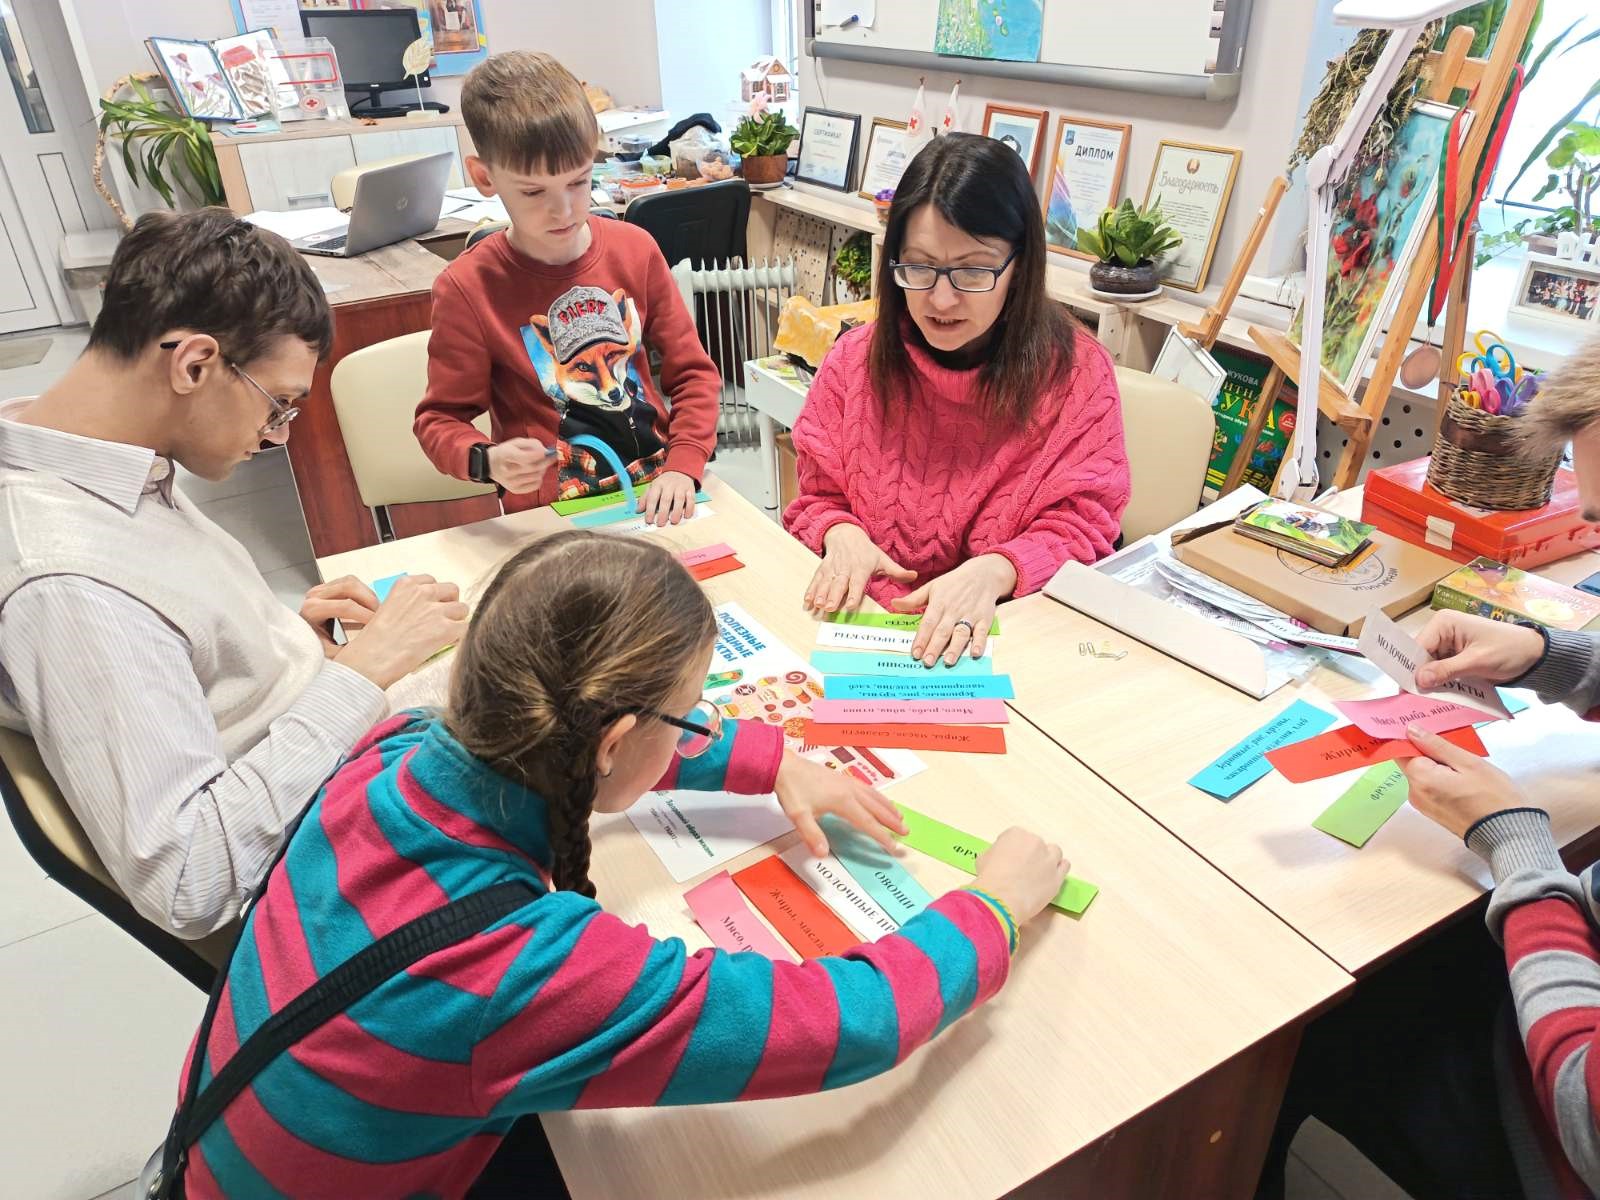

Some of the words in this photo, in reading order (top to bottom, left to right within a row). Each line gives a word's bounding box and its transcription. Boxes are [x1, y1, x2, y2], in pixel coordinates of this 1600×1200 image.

[1075, 145, 1114, 160] ДИПЛОМ
[1159, 171, 1219, 194] Благодарность
[719, 612, 766, 651] ПОЛЕЗНЫЕ
[720, 627, 754, 658] РЕДНЫЕ
[835, 632, 896, 644] ПРОДУКТЫ
[1378, 634, 1416, 673] МОЛОЧНЫЕ
[878, 661, 922, 670] ОВОЩИ
[1400, 709, 1430, 726] рыба,
[932, 731, 970, 742] Жиры,
[1321, 744, 1367, 761] Жиры,
[685, 823, 701, 840] образ
[815, 862, 878, 920] МОЛОЧНЫЕ
[874, 871, 917, 910] ОВОЩИ
[769, 889, 797, 921] Жиры,
[720, 915, 744, 946] Мясо,
